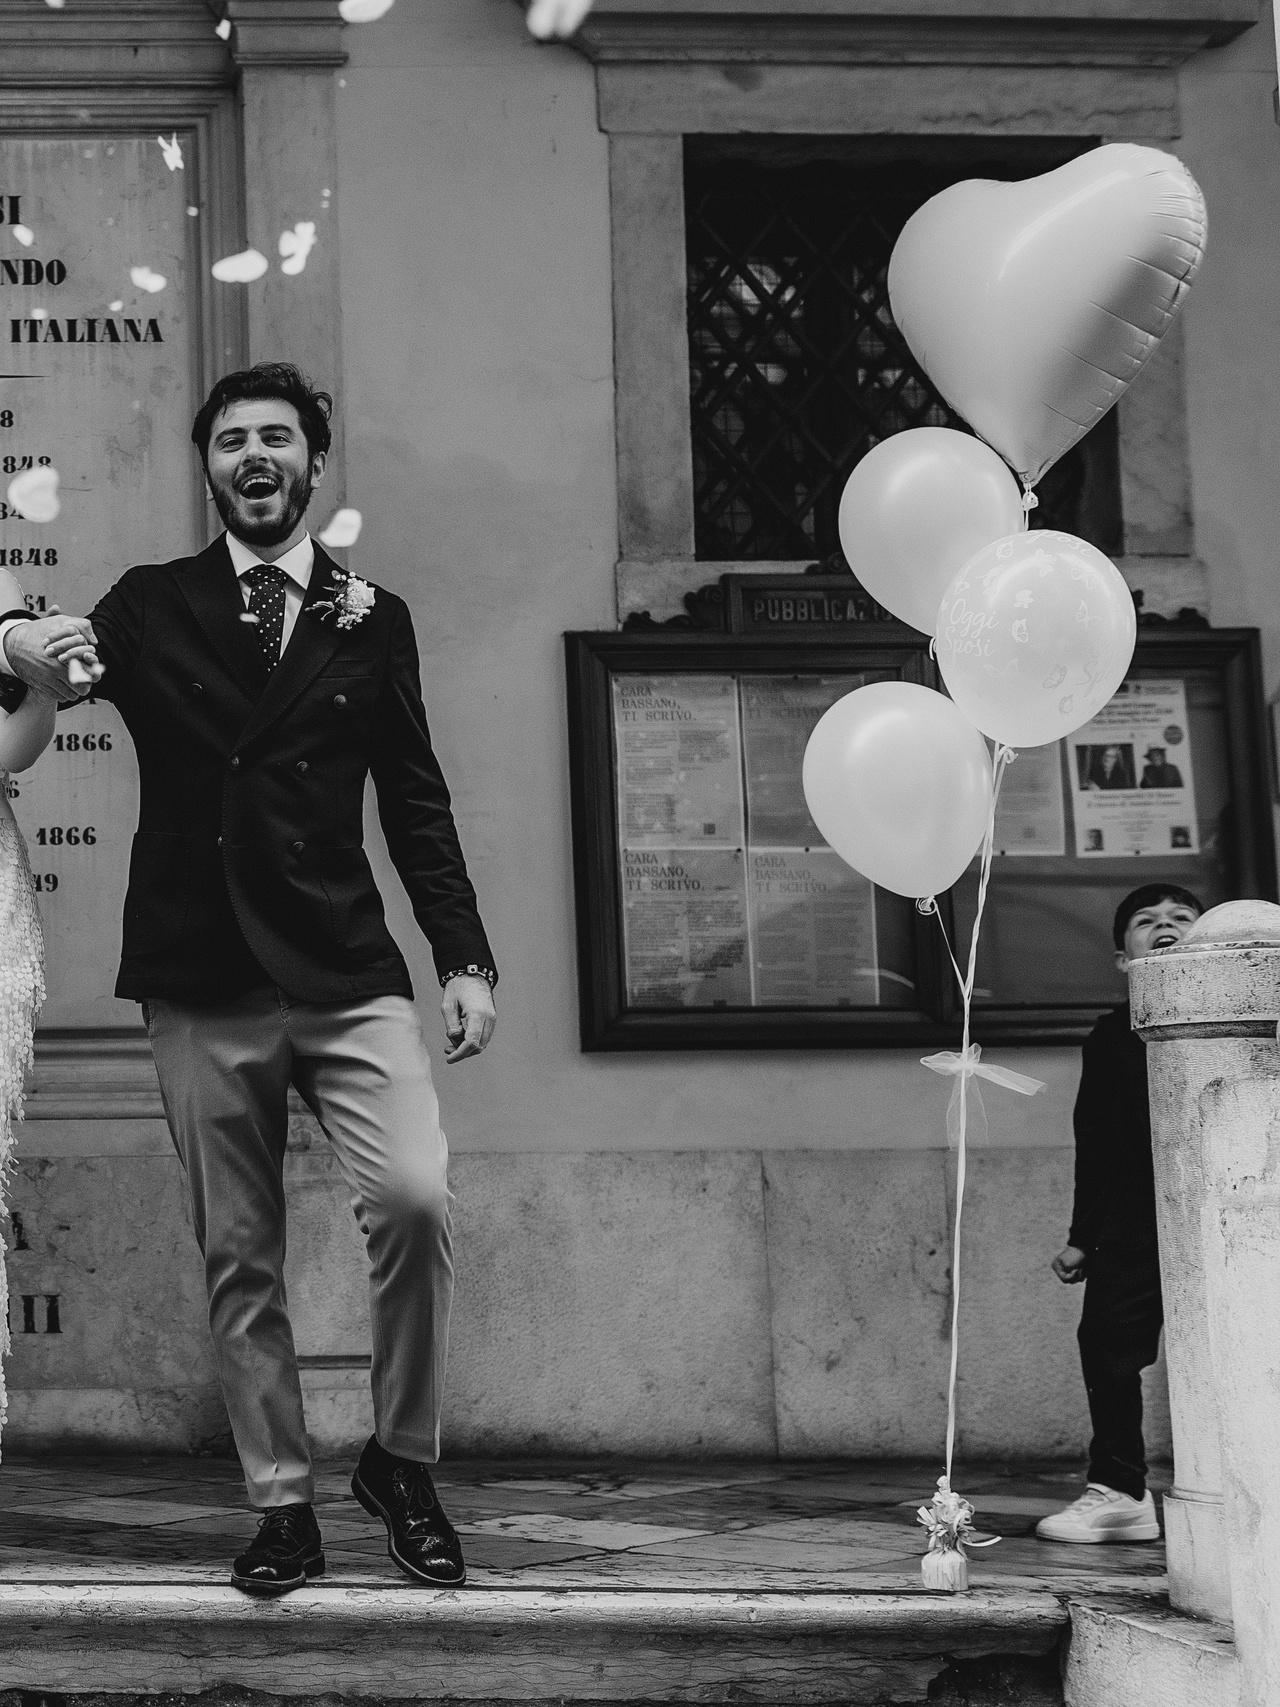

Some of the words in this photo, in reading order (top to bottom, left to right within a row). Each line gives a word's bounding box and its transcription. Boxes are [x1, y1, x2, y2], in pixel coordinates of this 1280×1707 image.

[10, 318, 167, 344] ITALIANA
[950, 598, 1000, 639] Oggi
[942, 626, 996, 661] Sposi
[53, 733, 113, 751] 1866
[36, 826, 97, 846] 1866
